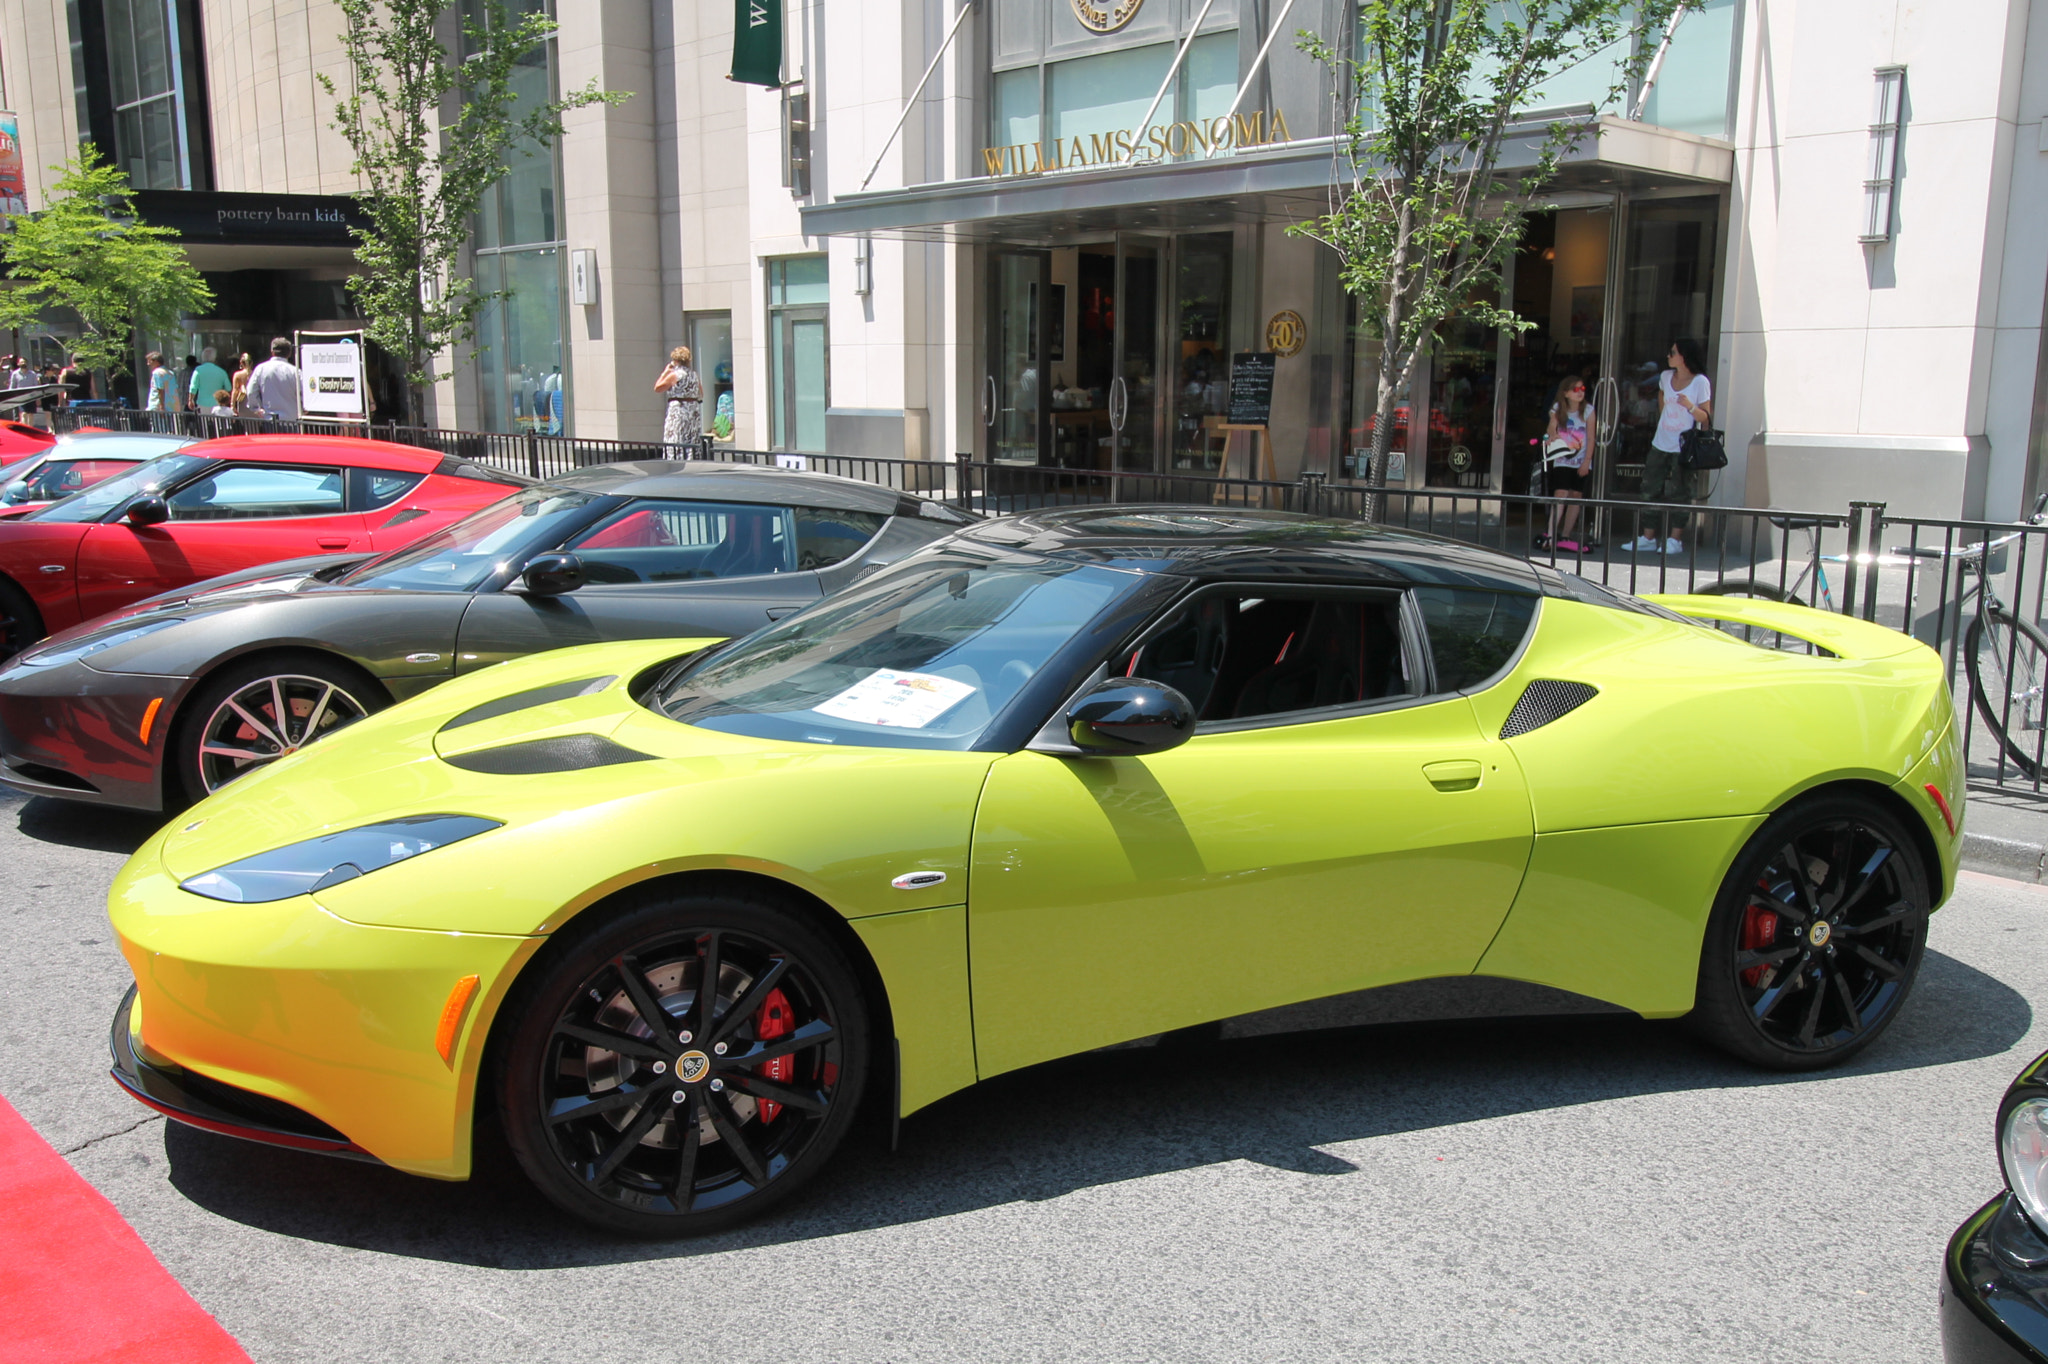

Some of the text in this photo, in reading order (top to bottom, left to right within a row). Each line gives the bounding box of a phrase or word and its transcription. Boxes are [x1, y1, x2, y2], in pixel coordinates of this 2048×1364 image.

[750, 0, 768, 28] W
[982, 108, 1292, 176] WILLIAMS-SONOMA
[217, 206, 346, 224] pottery barn kids
[684, 1058, 703, 1077] LOTUS
